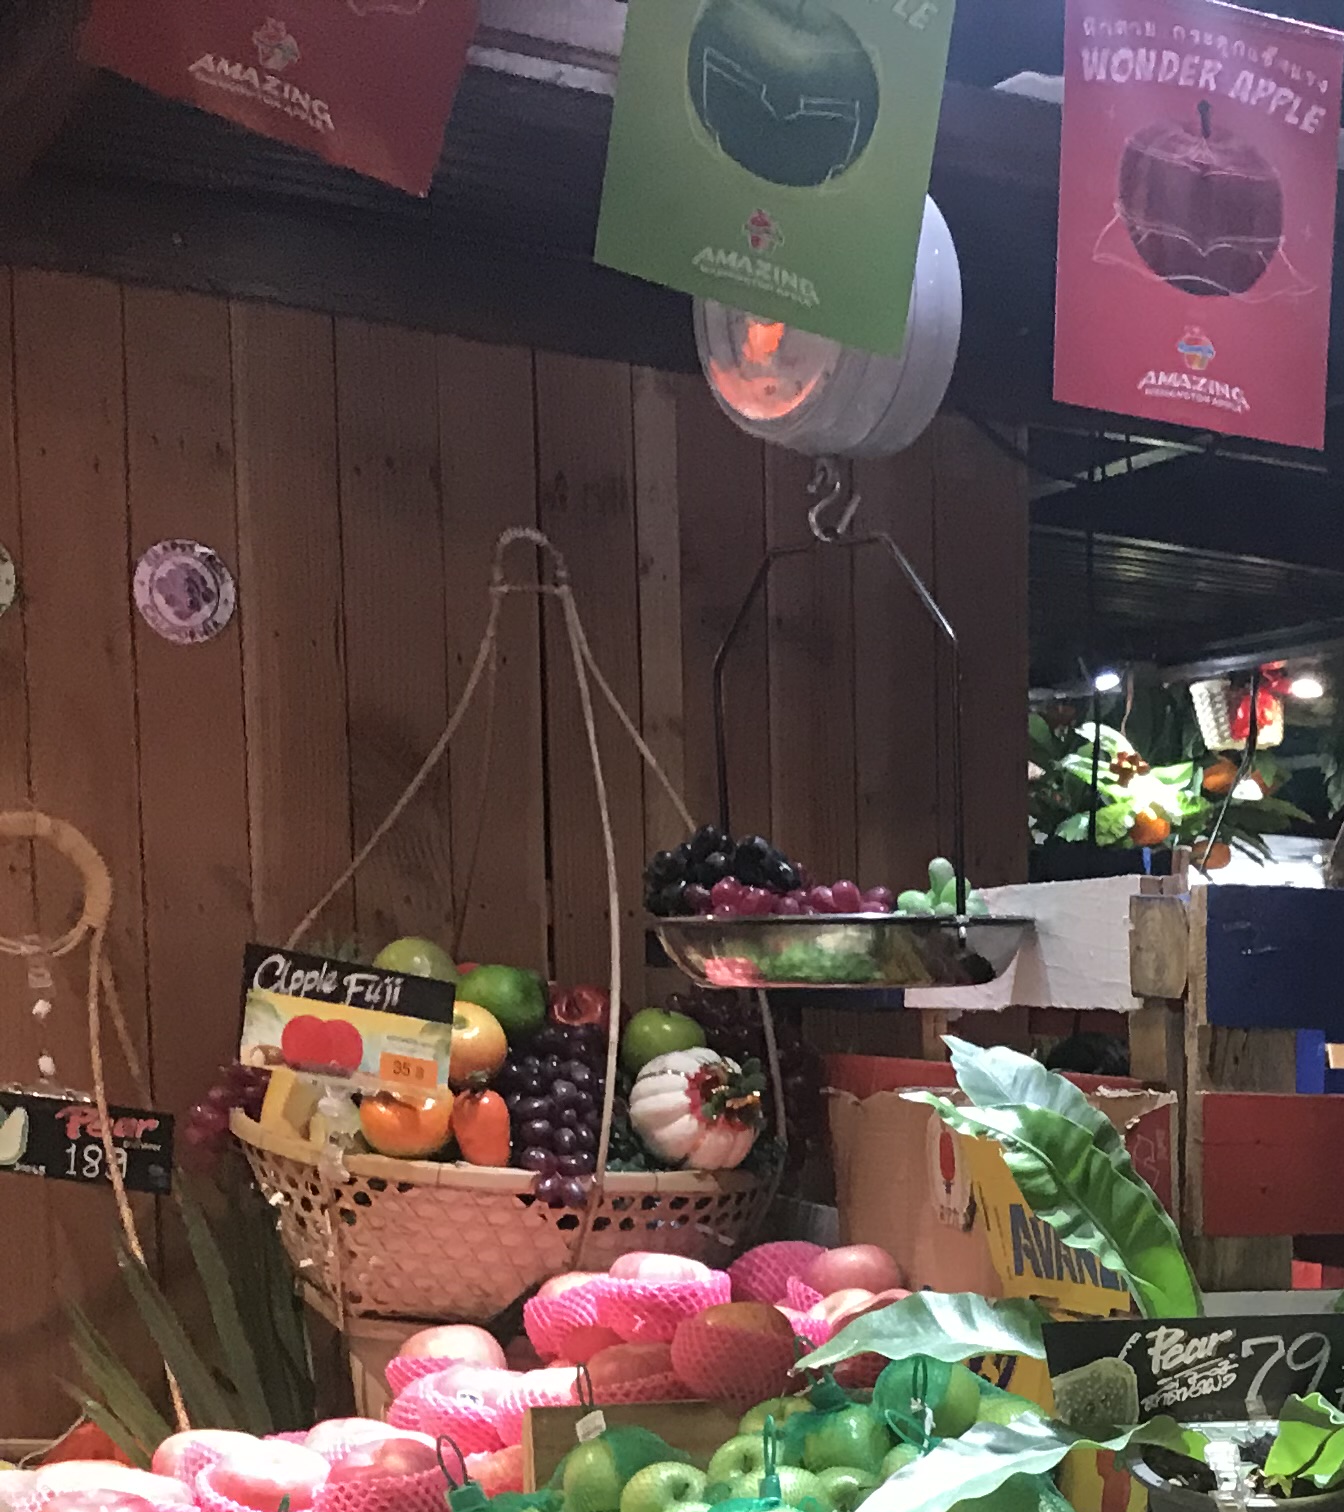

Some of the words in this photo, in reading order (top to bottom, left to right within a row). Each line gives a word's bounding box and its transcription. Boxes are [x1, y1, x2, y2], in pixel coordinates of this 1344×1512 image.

[187, 53, 336, 131] AMAZING
[1080, 47, 1224, 92] WONDER
[1227, 69, 1328, 134] APPLE
[690, 246, 820, 305] AMAZING
[1136, 370, 1251, 411] AMAZING
[1146, 1325, 1235, 1374] Pear
[1241, 1332, 1331, 1419] 79
